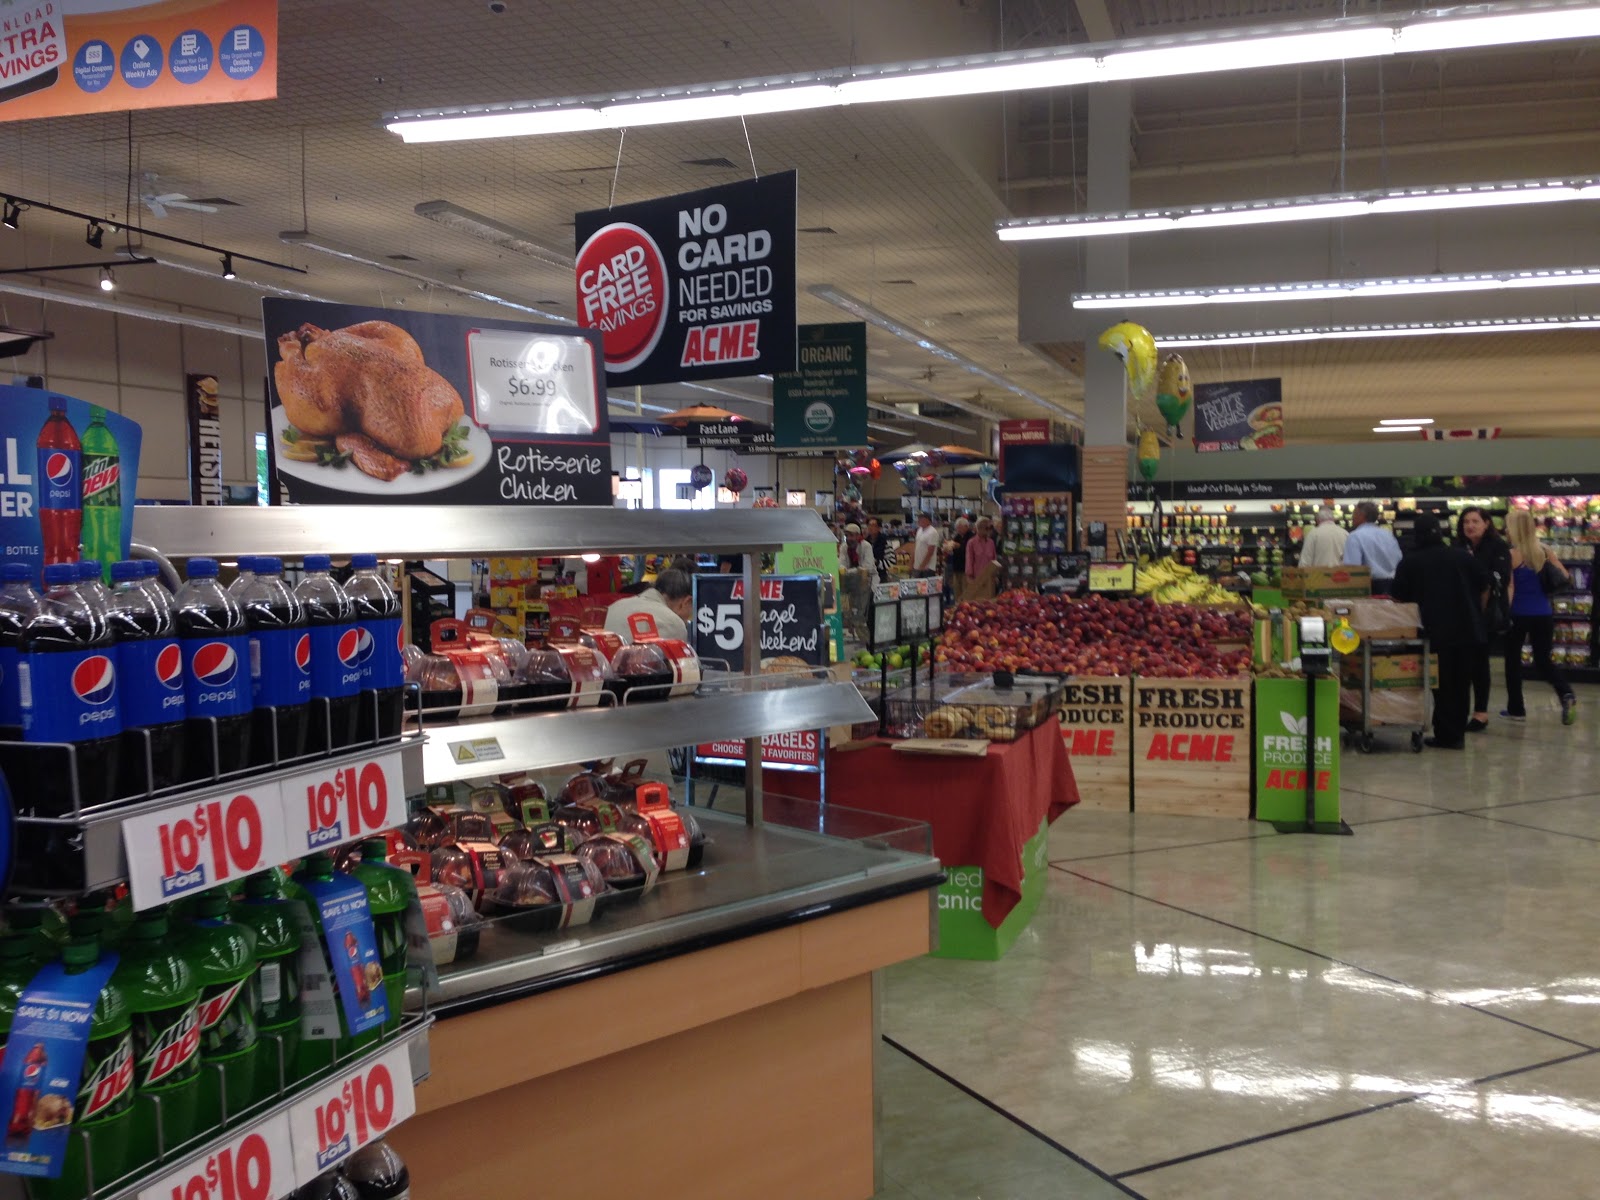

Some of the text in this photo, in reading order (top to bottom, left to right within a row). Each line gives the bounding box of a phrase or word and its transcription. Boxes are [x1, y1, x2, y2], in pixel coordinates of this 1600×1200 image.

[0, 21, 56, 58] TRA
[125, 69, 157, 79] Weekly Ads
[132, 61, 151, 70] Online
[173, 65, 197, 73] Shopping
[678, 203, 728, 239] NO
[678, 230, 772, 271] CARD
[580, 245, 645, 295] CARD
[583, 267, 653, 323] FREE
[679, 265, 773, 307] NEEDED
[679, 298, 773, 323] FOR SAVINGS
[680, 319, 760, 367] ACME
[490, 357, 533, 370] Rotisser
[801, 345, 852, 363] ORGANIC
[508, 375, 556, 396] $6.99
[699, 423, 739, 434] Fast Lane
[752, 434, 765, 443] ast
[497, 446, 601, 474] Rotisserie
[50, 489, 71, 498] pepsi
[500, 475, 577, 501] Chicken
[6, 546, 39, 555] BOTTLE
[730, 579, 784, 600] AME
[697, 603, 798, 650] $5 agel
[198, 688, 237, 704] pepsi
[1060, 685, 1123, 705] ESH
[1138, 688, 1244, 709] FRESH
[80, 707, 115, 726] pepsi
[1056, 708, 1124, 724] ODUCE
[1139, 712, 1244, 729] PRODUCE
[712, 743, 743, 755] CHOOSE
[761, 731, 816, 750] BAGELS
[1146, 734, 1235, 762] ACME
[768, 749, 815, 762] FAVORITES!
[306, 781, 338, 833] 10
[311, 827, 340, 845] FOR
[158, 818, 199, 878] 10
[165, 870, 203, 892] FOR
[323, 907, 341, 918] SAVE
[349, 898, 367, 910] NOW
[17, 1005, 45, 1018] SAVE
[60, 1010, 91, 1024] NOW
[315, 1097, 346, 1150] 10
[320, 1141, 350, 1163] FOR
